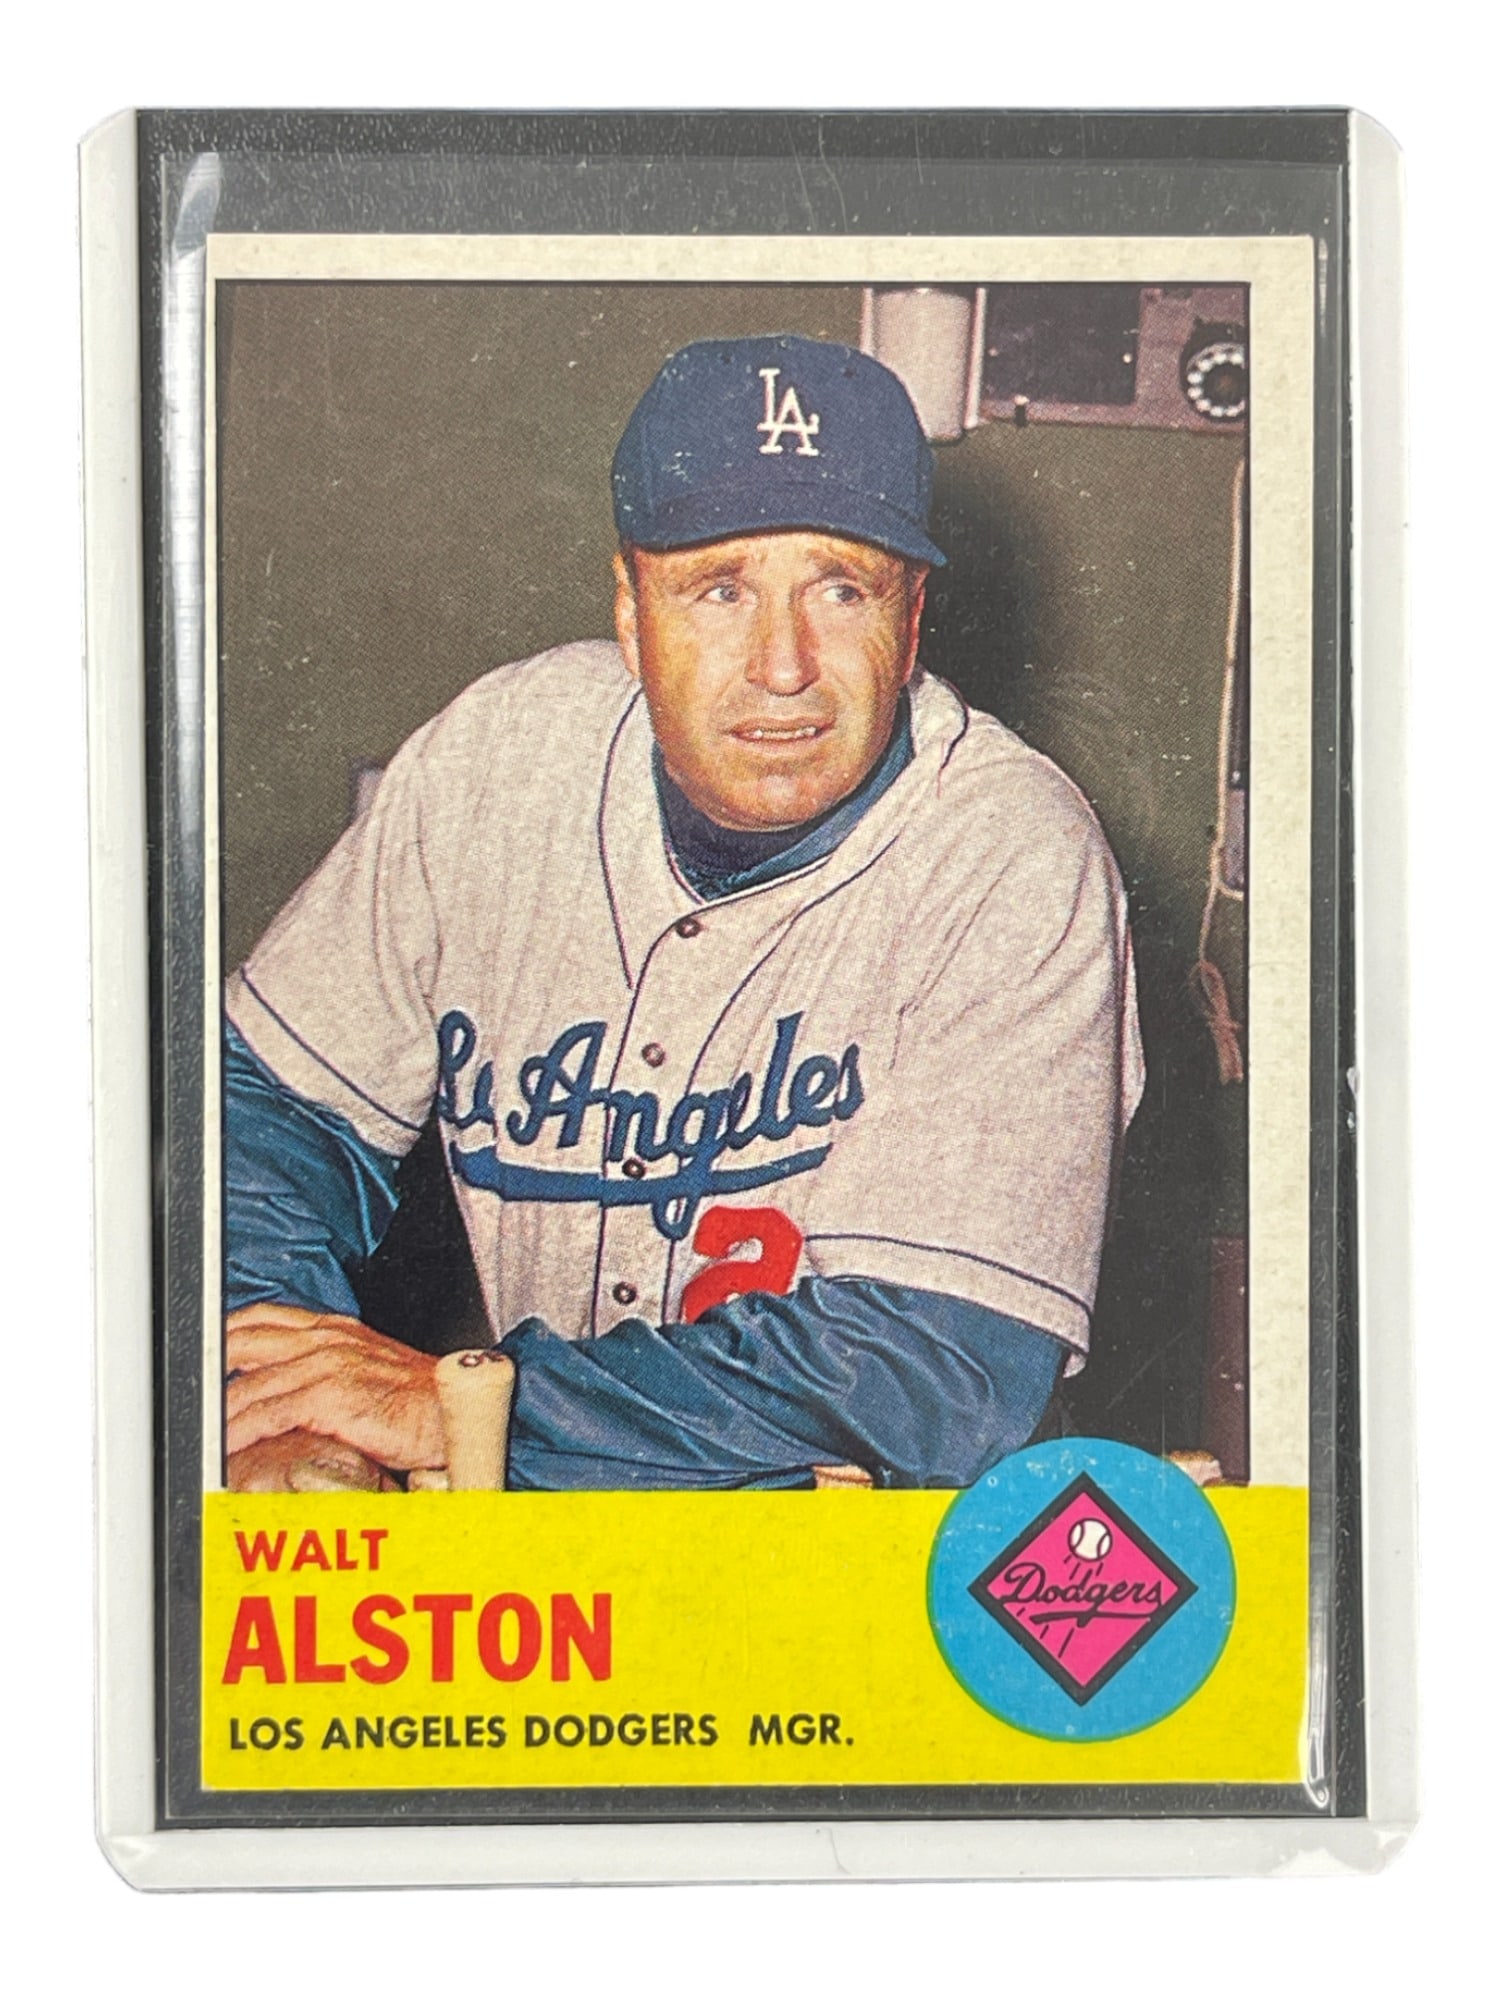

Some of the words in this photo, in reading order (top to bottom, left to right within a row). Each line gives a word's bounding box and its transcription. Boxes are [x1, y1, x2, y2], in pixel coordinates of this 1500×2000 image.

[757, 368, 819, 456] LA
[438, 1009, 494, 1129] Lo
[682, 1206, 803, 1324] 2
[234, 1528, 388, 1572] WALT
[222, 1592, 612, 1685] ALSTON
[1001, 1561, 1163, 1628] Dodgers
[230, 1717, 304, 1750] LOS
[321, 1716, 507, 1749] ANGELES
[525, 1713, 719, 1748] DODGERS
[749, 1713, 855, 1746] MGR.
